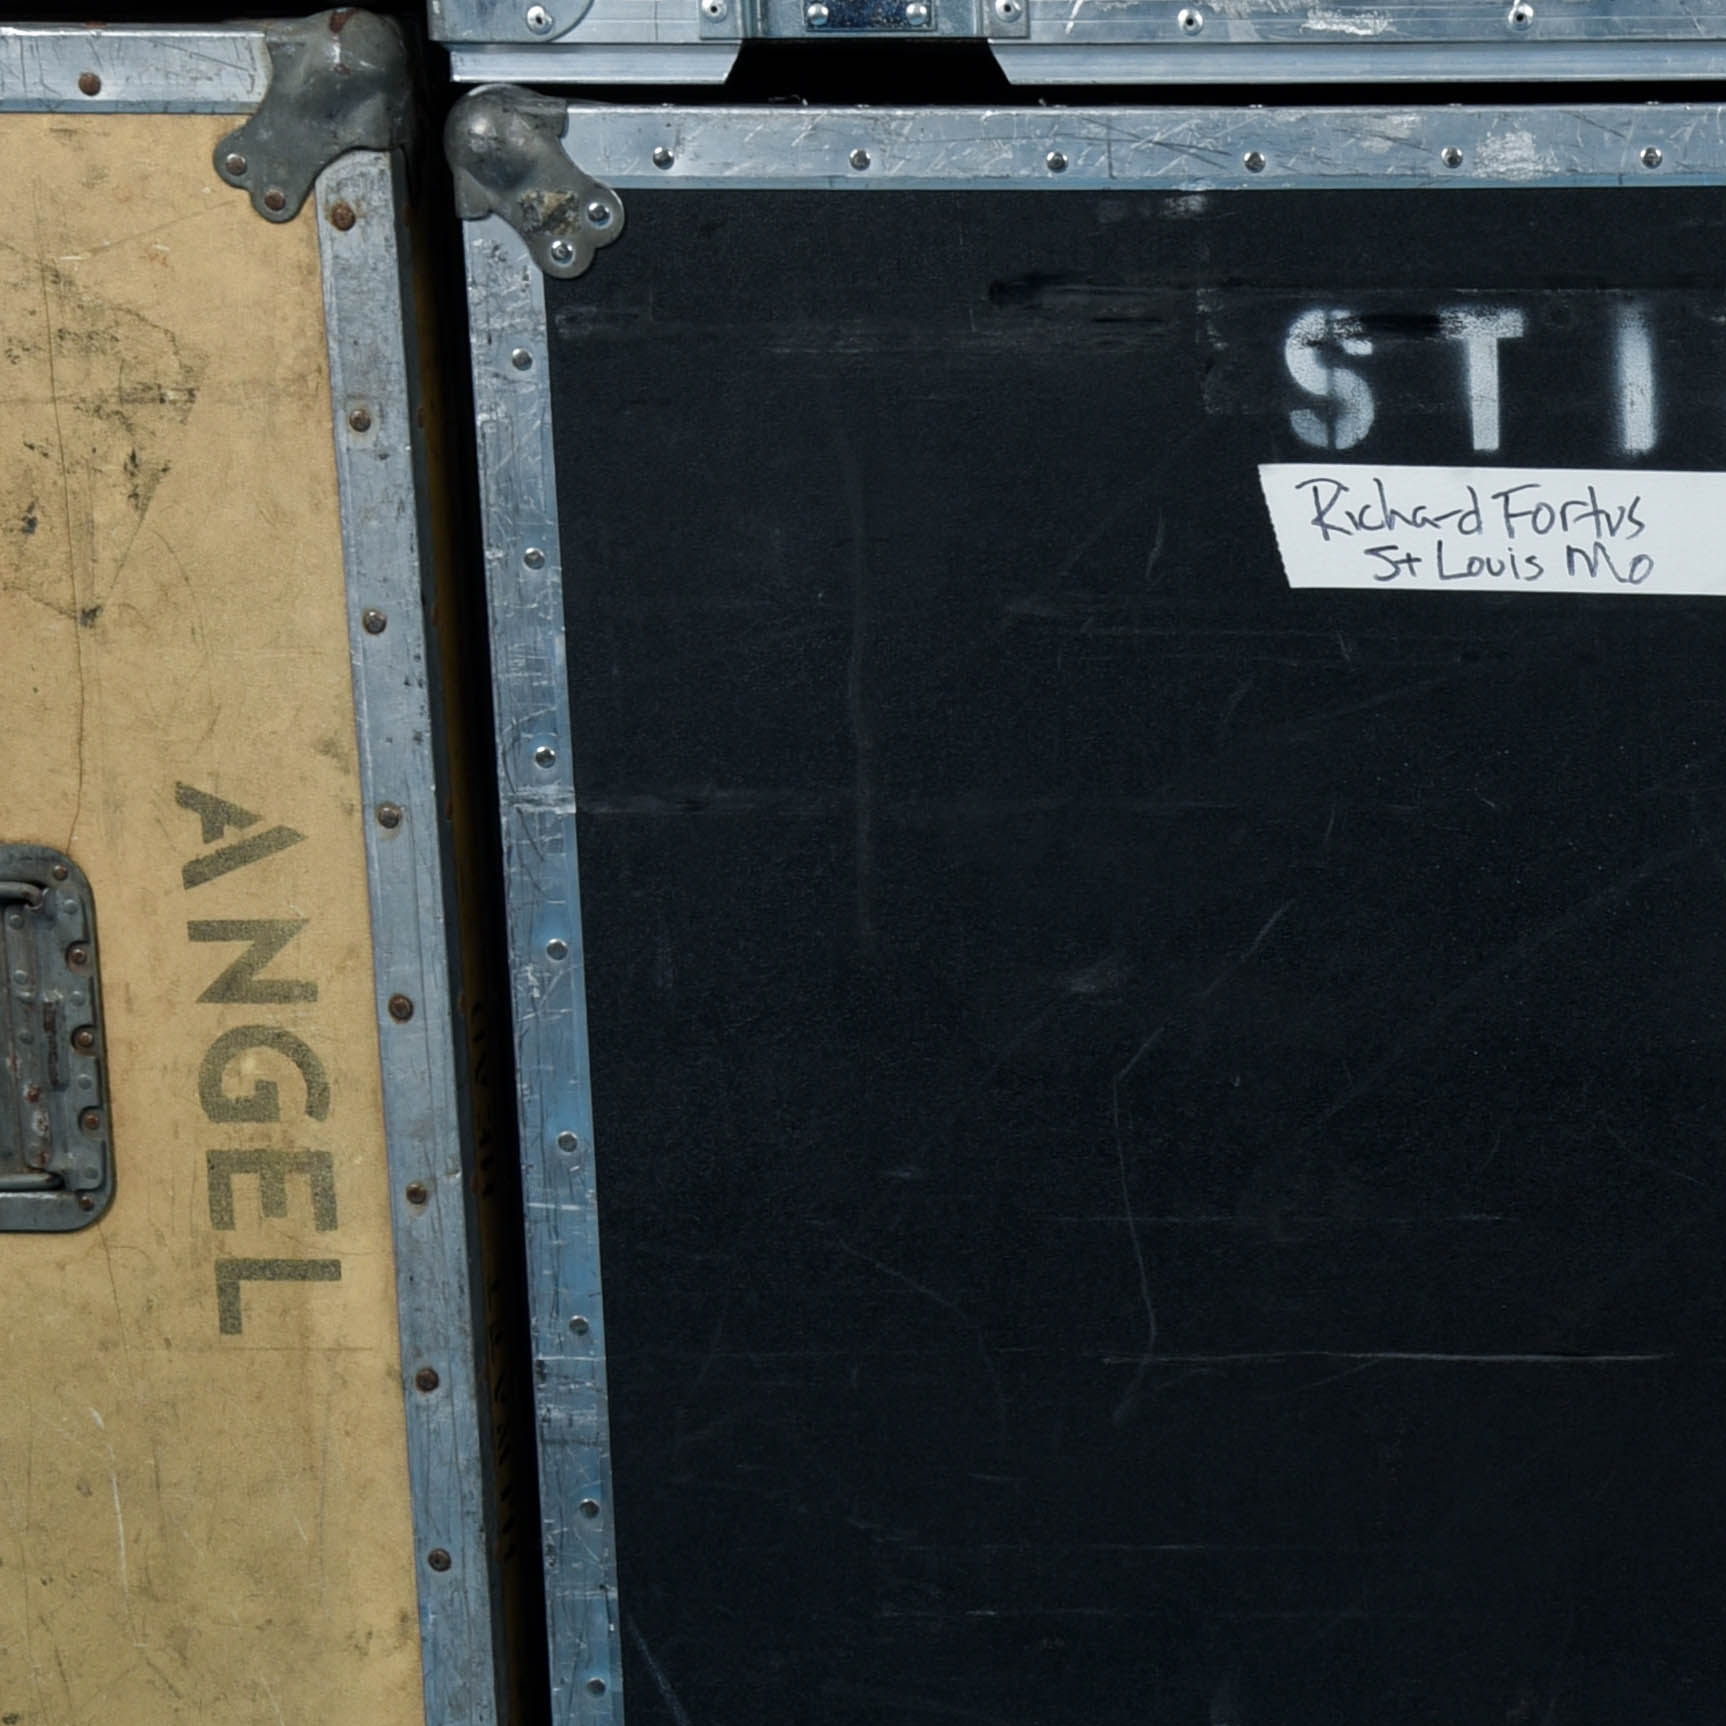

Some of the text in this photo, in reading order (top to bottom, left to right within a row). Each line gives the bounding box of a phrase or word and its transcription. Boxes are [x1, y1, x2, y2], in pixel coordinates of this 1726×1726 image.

[1295, 478, 1482, 543] Richard
[1364, 546, 1422, 576] St
[1437, 540, 1544, 576] Louis
[176, 782, 341, 1335] ANGEL
